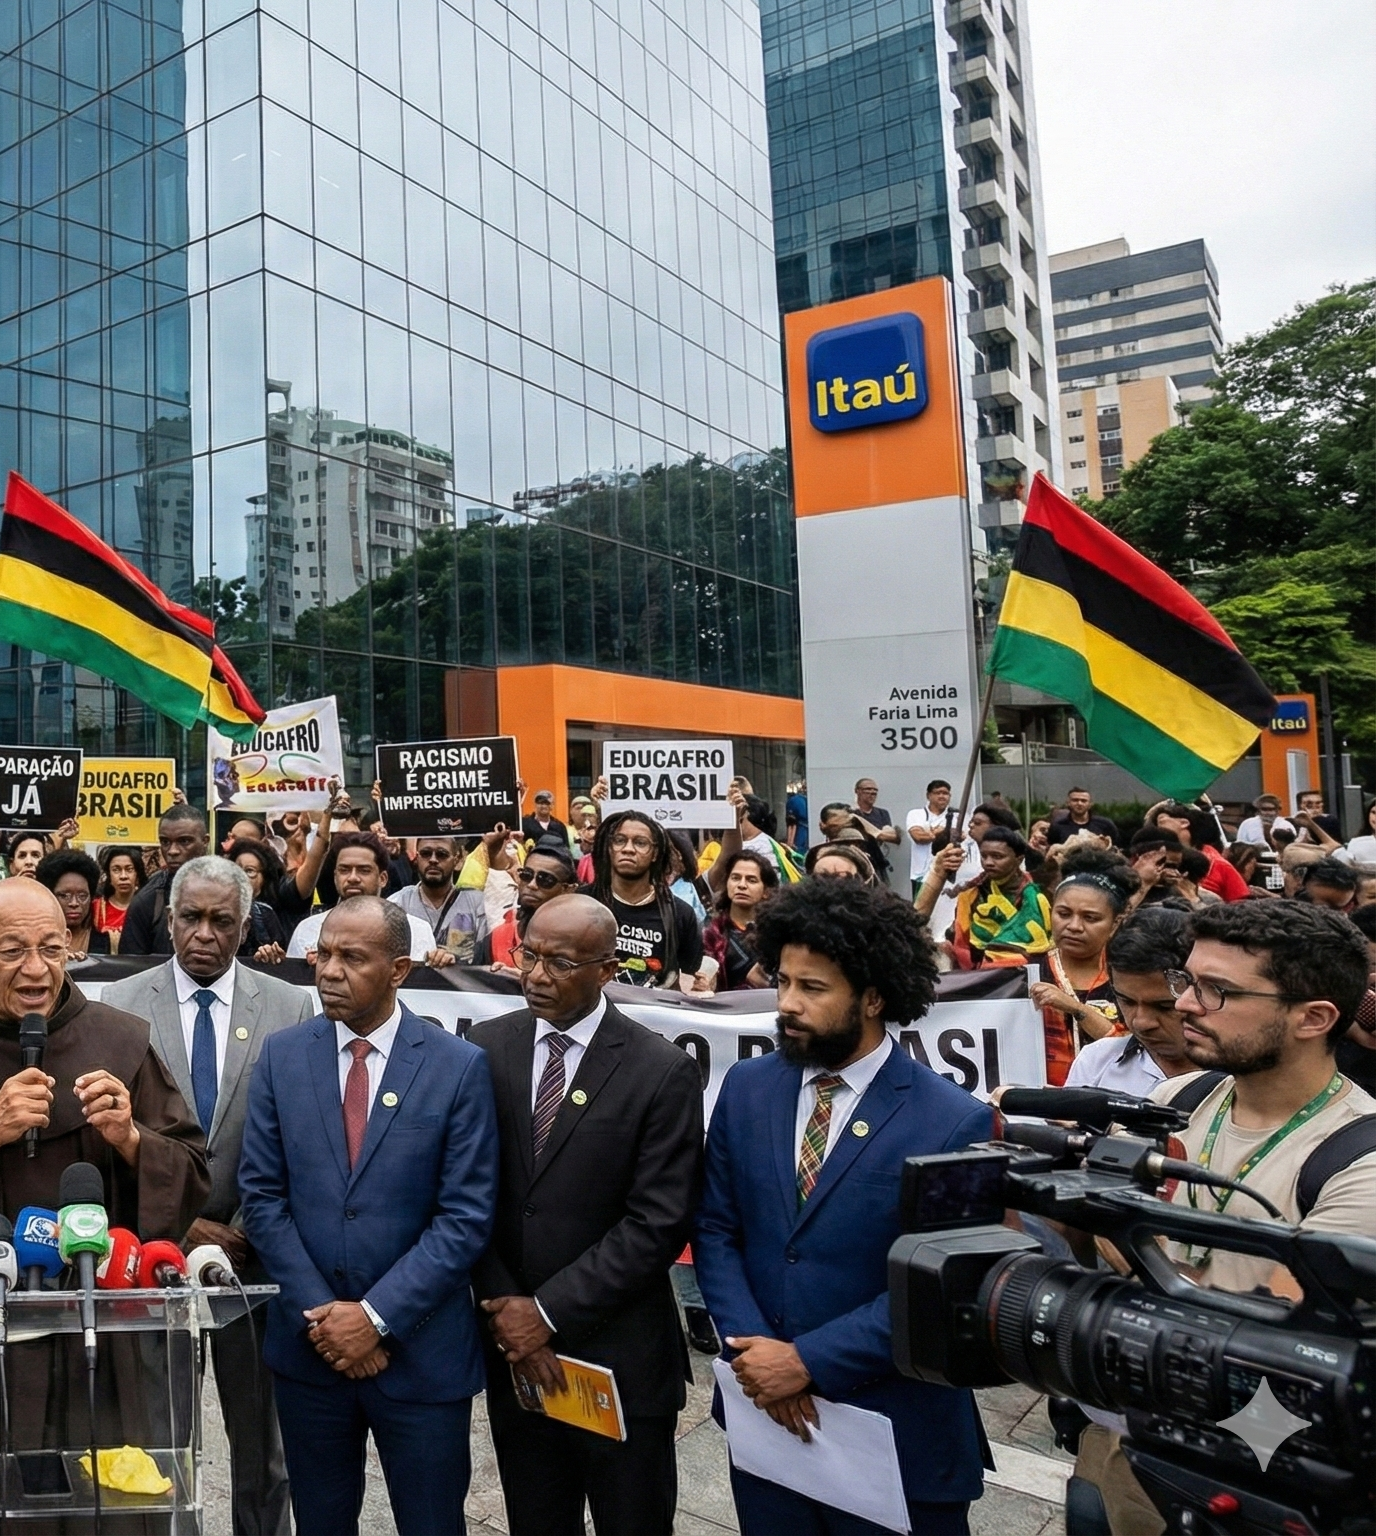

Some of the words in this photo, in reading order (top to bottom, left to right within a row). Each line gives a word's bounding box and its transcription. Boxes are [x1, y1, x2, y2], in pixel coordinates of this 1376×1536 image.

[816, 362, 917, 417] Itaú
[889, 684, 958, 701] Avenida
[869, 705, 911, 720] Faria
[916, 704, 958, 719] Lima
[1271, 716, 1307, 730] Itaú
[880, 725, 959, 751] 3500
[399, 746, 493, 769] RACISMO
[610, 749, 725, 768] EDUCAFRO
[406, 766, 419, 791] É
[424, 769, 491, 790] CRIME
[610, 773, 728, 801] BRASIL
[1, 777, 42, 815] JÁ
